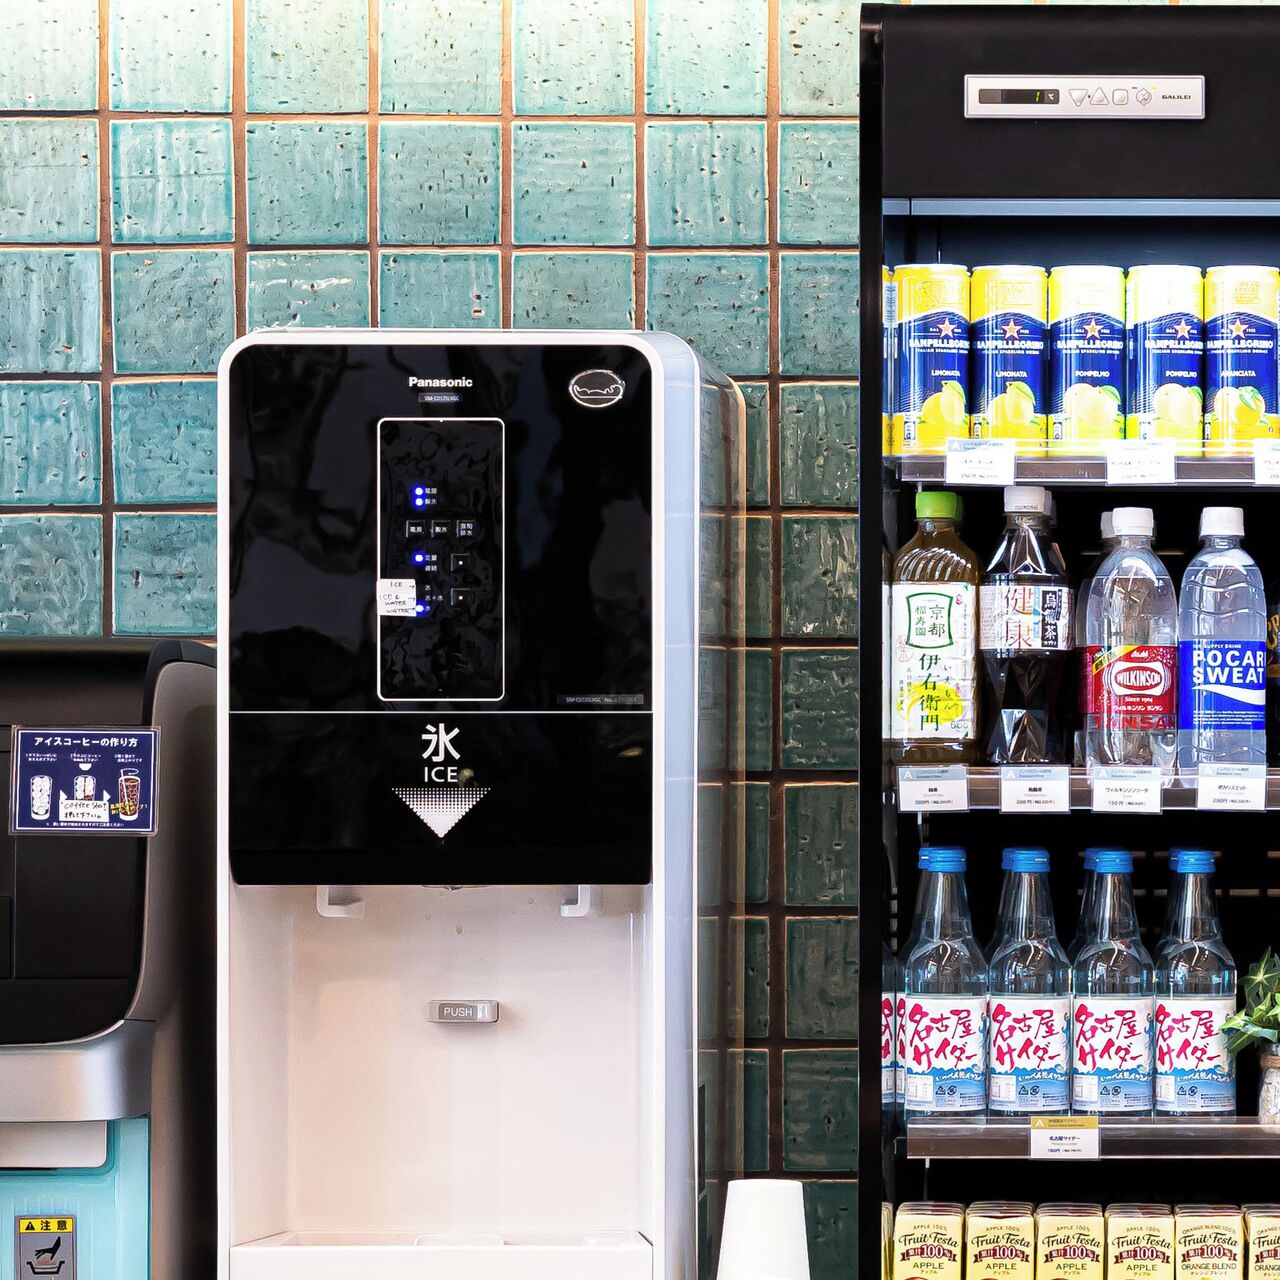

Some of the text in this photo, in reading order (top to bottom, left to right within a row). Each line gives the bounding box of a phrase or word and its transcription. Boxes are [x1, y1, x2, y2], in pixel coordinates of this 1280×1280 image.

[408, 376, 473, 387] Panasonic
[929, 604, 945, 638] 京都
[1116, 670, 1161, 687] WILKINSON
[1193, 667, 1264, 684] SWEAT
[919, 653, 941, 732] 伊右衛門
[34, 737, 138, 747] アイスコーヒーの作り方
[421, 723, 461, 763] 氷
[423, 766, 458, 783] ICE
[908, 1003, 977, 1047] 名古屋
[992, 1003, 1060, 1047] 名古屋
[1075, 1003, 1142, 1047] 名古屋
[1156, 1003, 1220, 1047] 名古屋
[912, 1038, 977, 1071] サイダー
[995, 1038, 1061, 1071] サイダー
[1078, 1038, 1143, 1071] サイダー
[1158, 1038, 1221, 1071] サイダー
[40, 1220, 68, 1231] 注意
[898, 1231, 960, 1248] Fruit Festa
[971, 1233, 1032, 1249] Fruit Festa
[1042, 1232, 1102, 1249] Fruit Festa
[1112, 1233, 1173, 1250] Fruit Festa
[1178, 1232, 1240, 1247] Fruit Festa
[1056, 1263, 1087, 1271] APPLE
